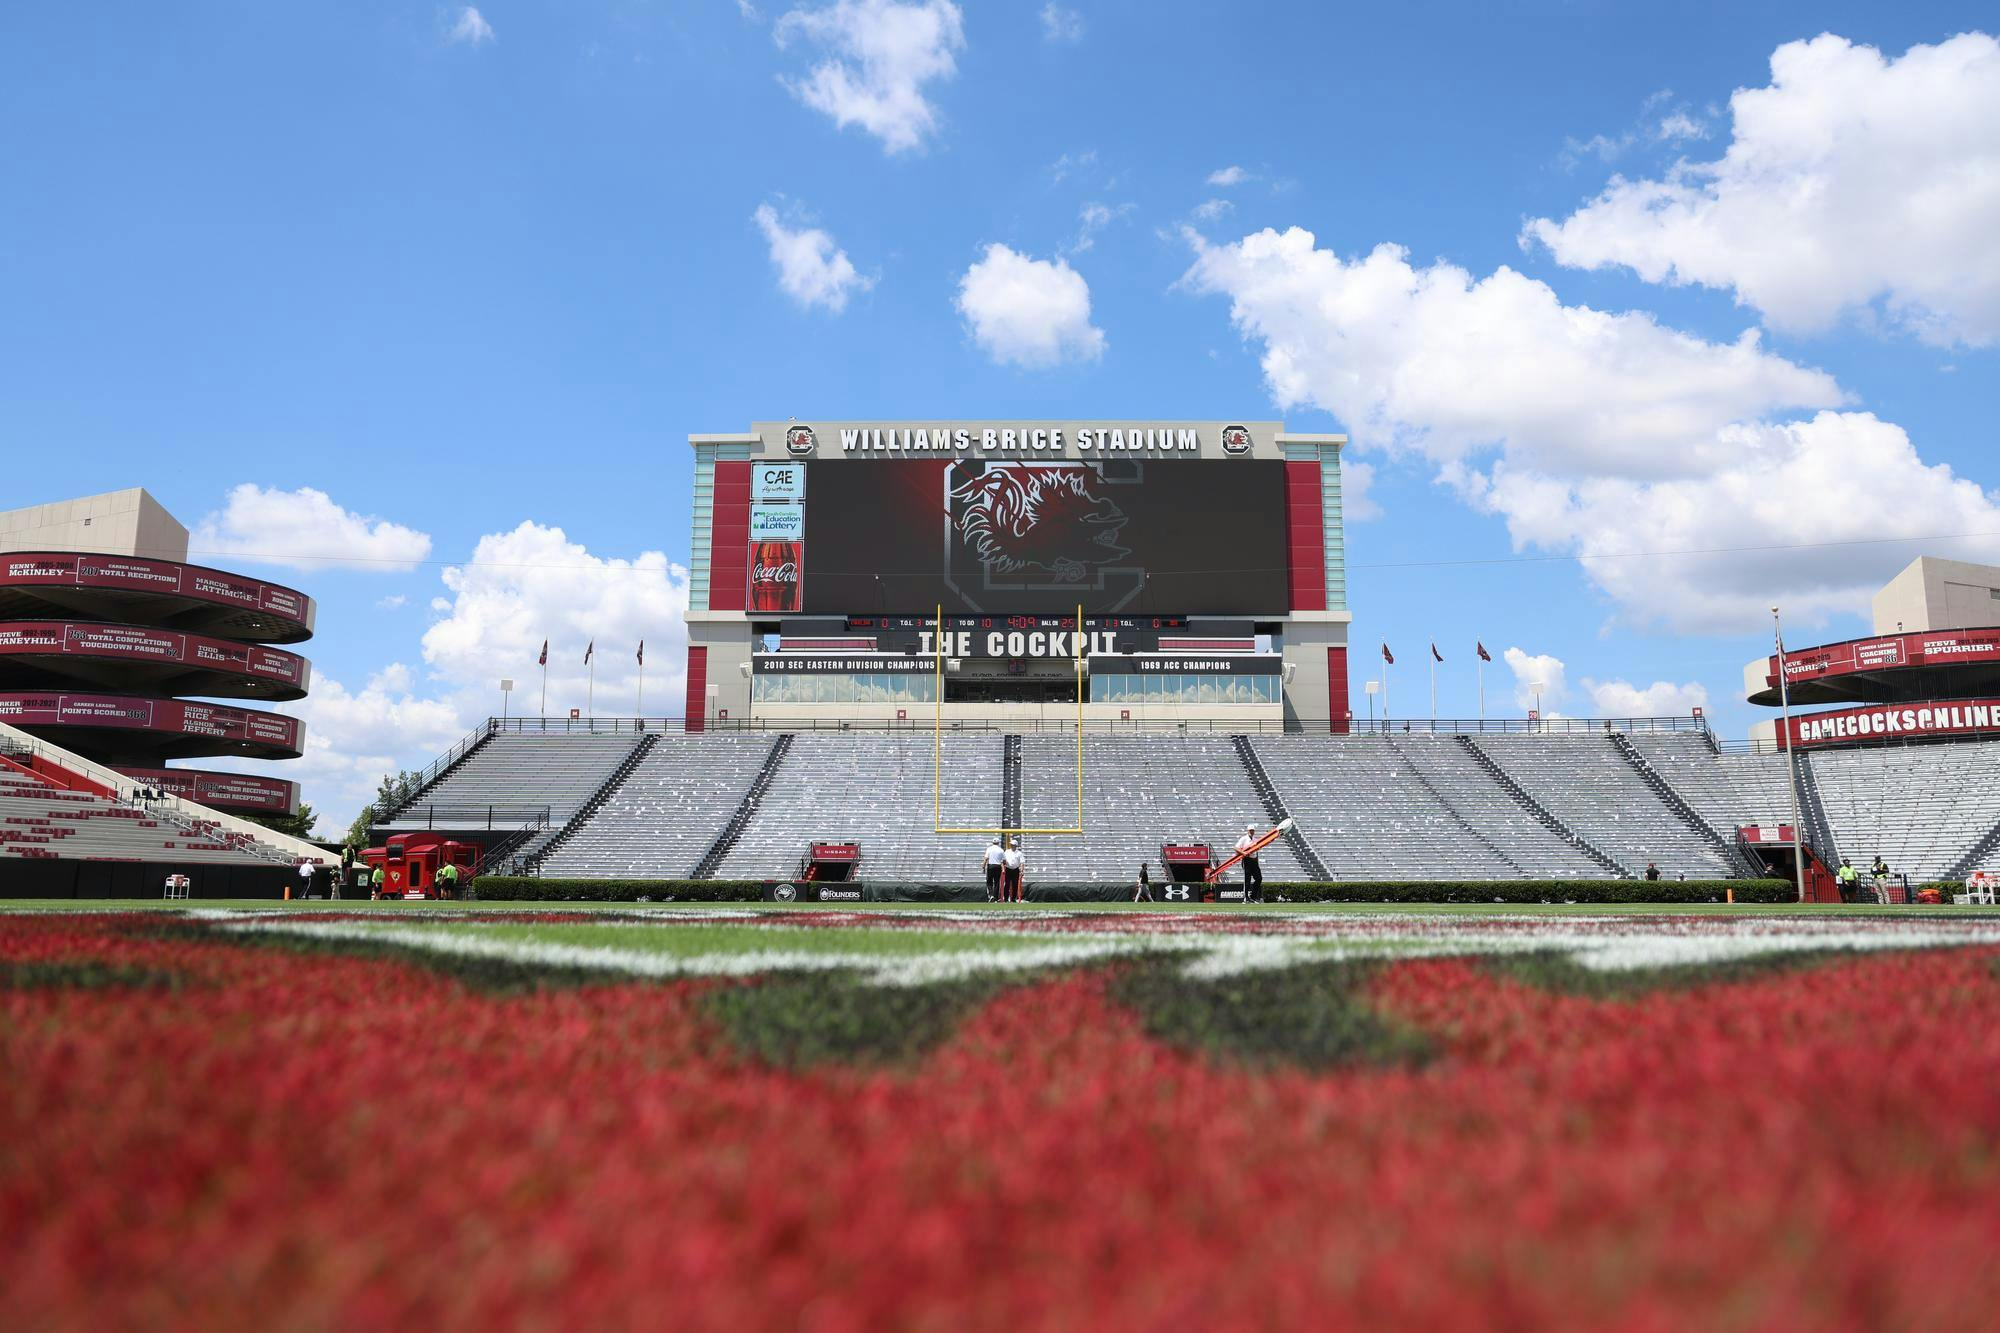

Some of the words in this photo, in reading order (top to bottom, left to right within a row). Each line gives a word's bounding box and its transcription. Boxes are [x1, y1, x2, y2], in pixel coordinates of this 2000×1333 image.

[840, 428, 1062, 450] WILLIAMS-BRICE
[1078, 428, 1197, 450] STADIUM
[764, 471, 793, 484] CAE
[765, 521, 797, 530] Lottery
[99, 569, 126, 577] TOTAL
[127, 571, 177, 583] RECEPTIONS
[752, 562, 798, 583] Coca-Cola
[196, 577, 229, 589] MARCUS
[115, 636, 172, 647] COMPLETIONS
[919, 632, 971, 656] THE
[987, 631, 1117, 656] COCKPIT
[1924, 640, 1957, 648] STEVE
[80, 641, 133, 651] TOUCHDOWN
[134, 645, 165, 654] PASSES
[1925, 644, 1994, 655] SPURRIER
[197, 650, 225, 661] ELLIS
[1860, 648, 1898, 658] COACHING
[1884, 654, 1898, 664] 86
[764, 661, 785, 669] 2010
[788, 661, 804, 669] SEC
[807, 661, 844, 669] EASTERN
[846, 661, 884, 669] DIVISION
[887, 661, 935, 669] CHAMPIONS
[1140, 661, 1161, 670] 1969
[1163, 661, 1180, 670] ACC
[1183, 661, 1231, 670] CHAMPIONS
[62, 707, 92, 715] POINTS
[94, 709, 126, 717] SCORED
[184, 705, 214, 715] SIDNEY
[184, 711, 209, 721] RICE
[182, 725, 226, 737] JEFFERY
[207, 791, 231, 799] CAREER
[828, 890, 860, 898] FOUNDERS
